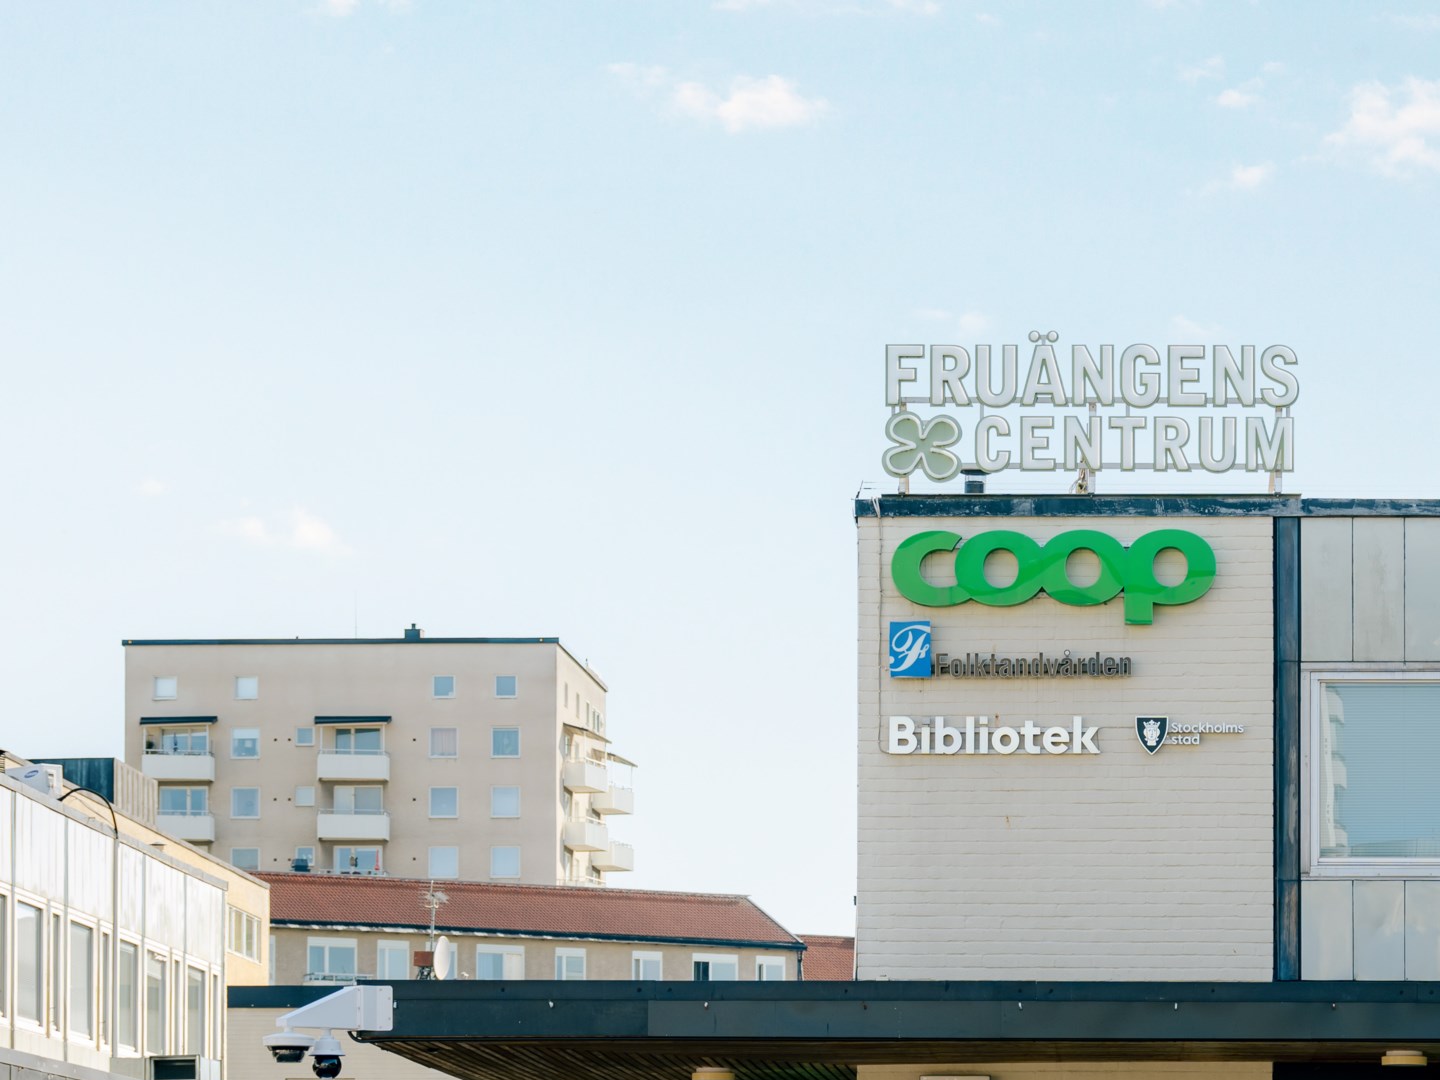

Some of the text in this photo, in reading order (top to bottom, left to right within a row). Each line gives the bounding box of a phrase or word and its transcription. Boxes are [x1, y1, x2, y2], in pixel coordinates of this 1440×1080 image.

[885, 330, 1300, 408] FRUÄNGENS
[975, 415, 1295, 472] CENTRUM
[891, 529, 1217, 625] coop
[935, 649, 1132, 678] Folktandvården
[889, 716, 1100, 754] Bibliotek
[1171, 721, 1245, 734] Stockholms
[1171, 734, 1200, 745] stad
